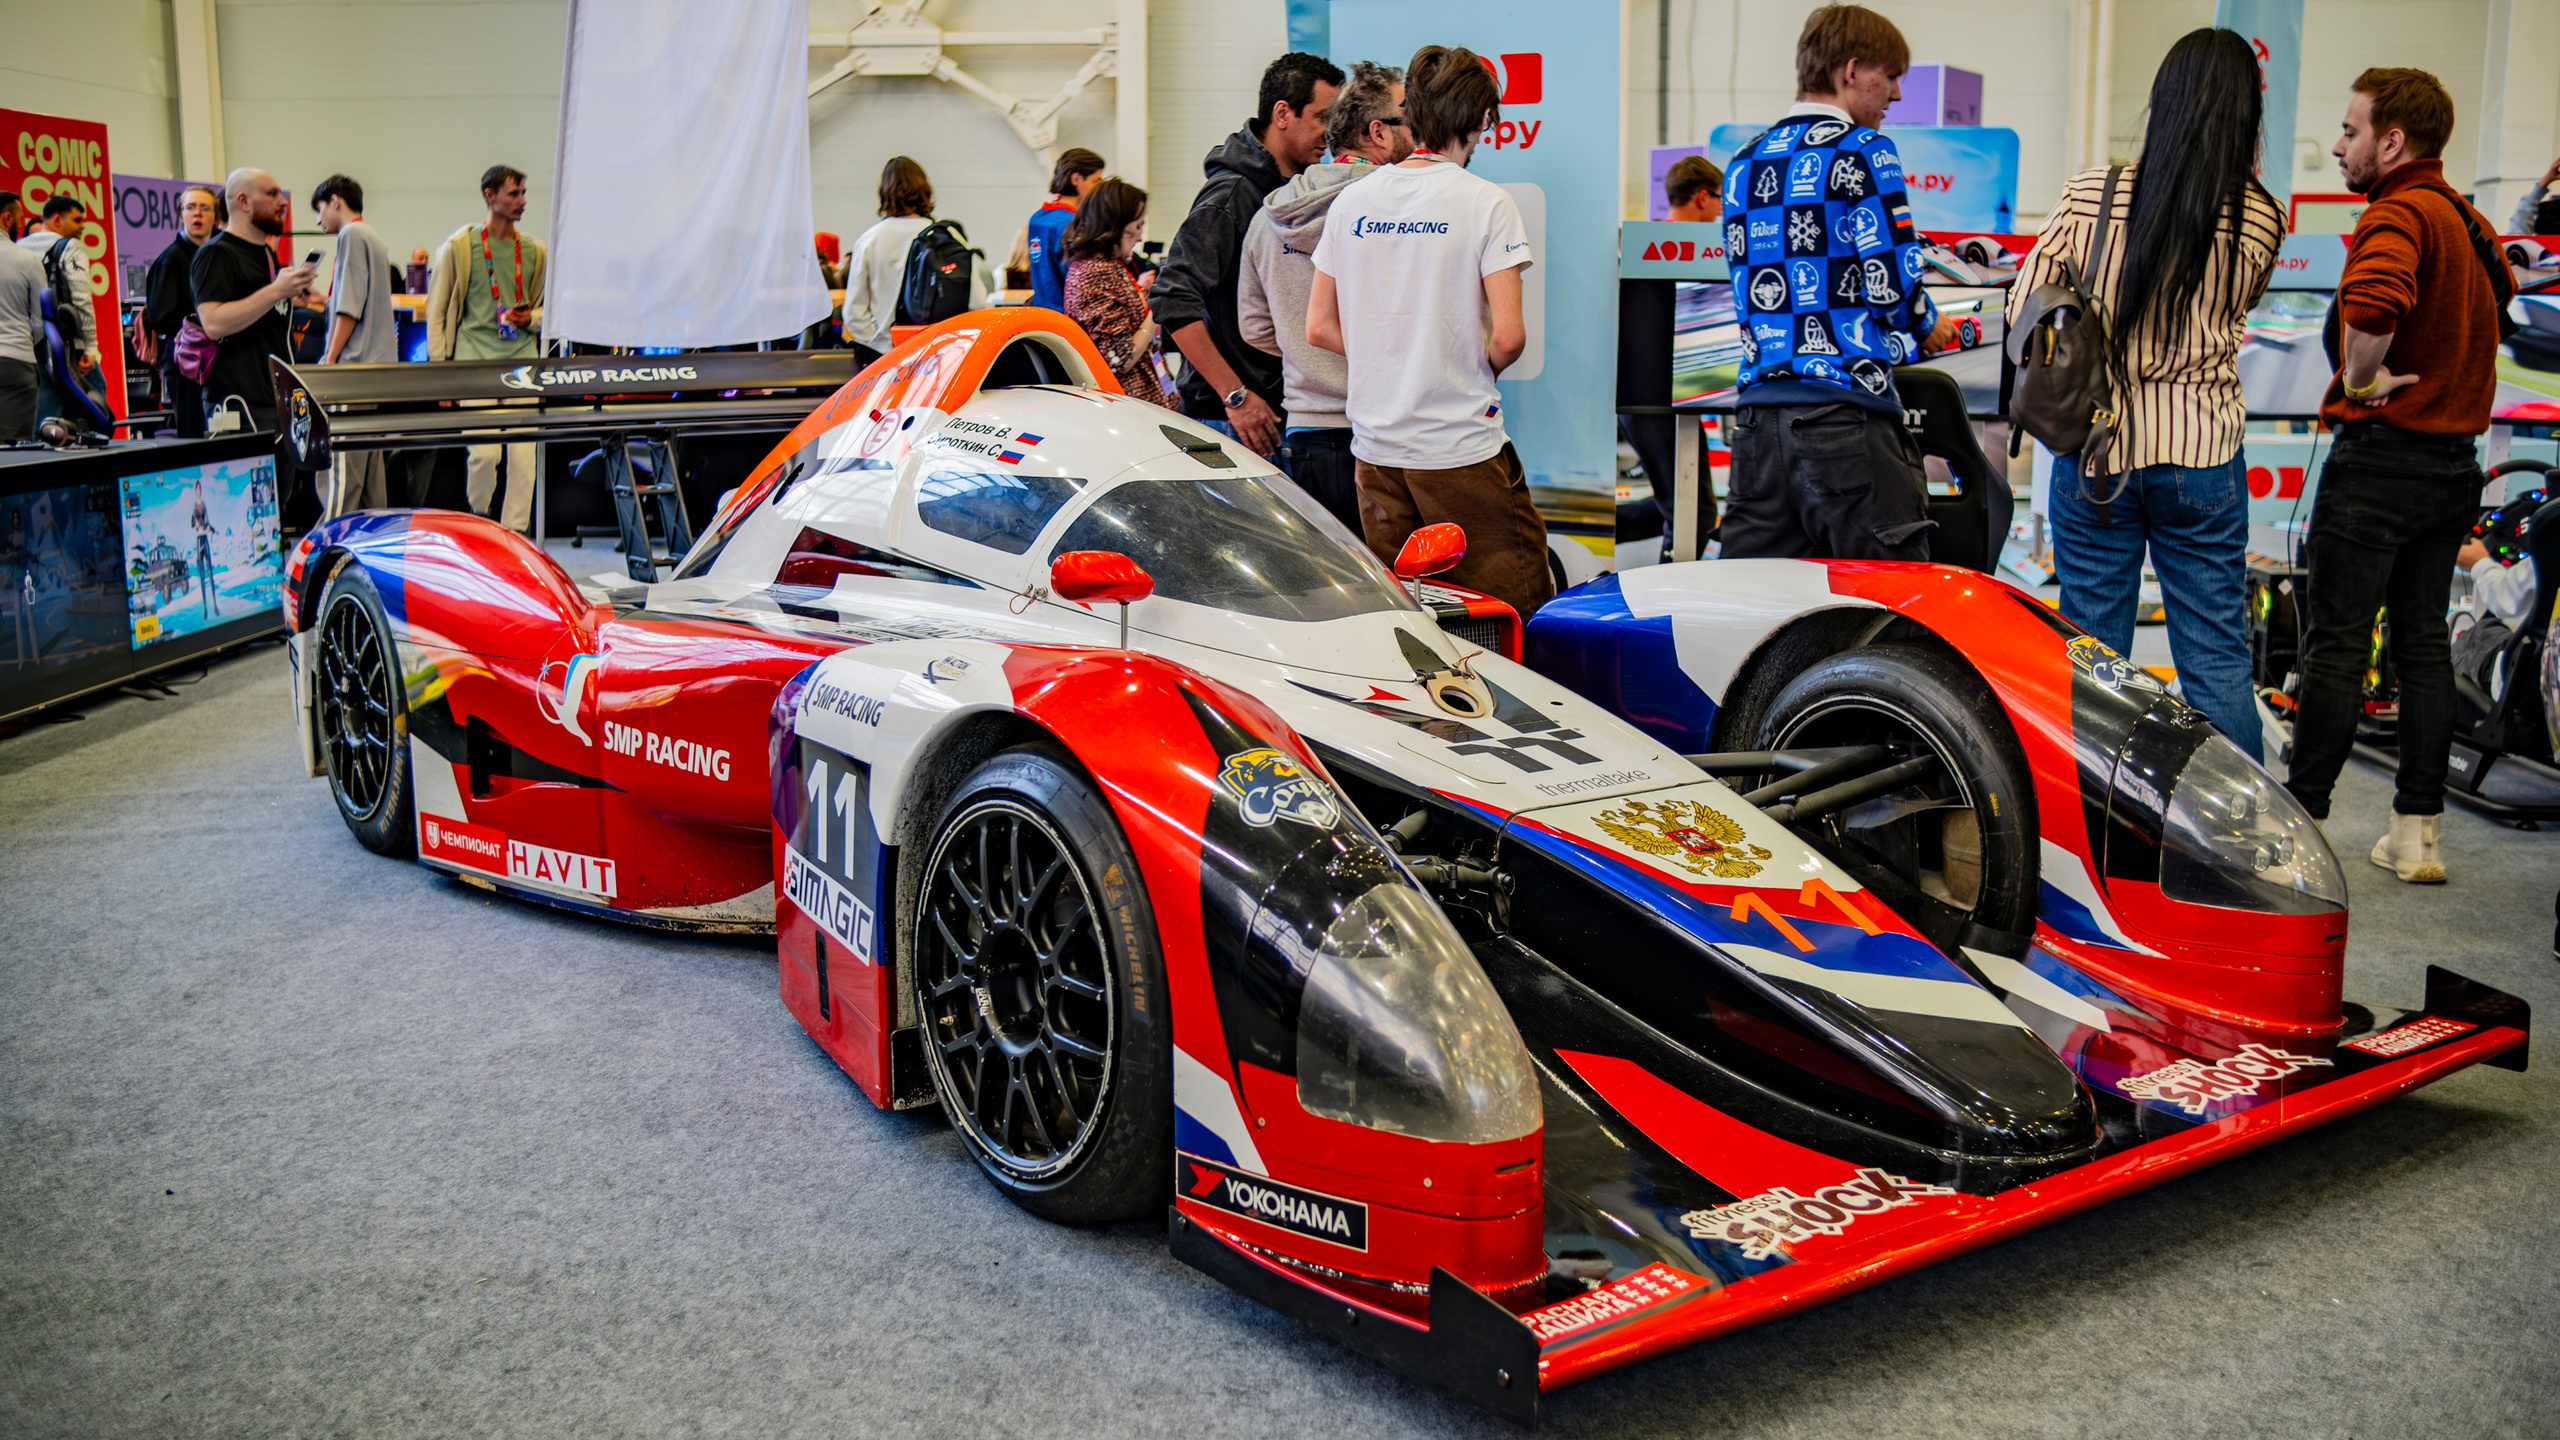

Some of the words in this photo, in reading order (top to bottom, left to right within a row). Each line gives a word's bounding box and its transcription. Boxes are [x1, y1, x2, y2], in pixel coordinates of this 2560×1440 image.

[18, 131, 102, 179] COMIC
[1477, 120, 1542, 151] .ру
[21, 175, 105, 220] CON
[1366, 222, 1396, 234] SMP
[1397, 222, 1449, 234] RACING
[540, 369, 597, 386] SMP
[601, 366, 698, 384] RACING
[839, 376, 875, 408] SMP
[927, 432, 988, 455] Сироткин
[989, 443, 1001, 458] С.
[945, 417, 992, 437] Петров
[993, 426, 1009, 440] В.
[812, 683, 840, 708] SMP
[839, 689, 885, 728] RACING
[603, 720, 643, 757] SMP
[646, 731, 730, 782] RACING
[1535, 769, 1651, 796] thermaltake
[807, 758, 857, 880] 11
[440, 829, 501, 858] ЧЕМПИОНАТ
[511, 842, 612, 893] HAVIT
[785, 854, 871, 955] SIMAGIC
[1730, 877, 1885, 953] 11
[1118, 904, 1147, 1013] MICHELIN
[2121, 1063, 2193, 1092] fitness
[2158, 1045, 2311, 1107] SHOCK
[1224, 1176, 1352, 1238] YOKOHAMA
[1687, 1193, 1782, 1229] fitness
[1725, 1169, 1931, 1248] SHOCK
[1518, 1289, 1618, 1327] РАСНАЯ
[1533, 1298, 1638, 1341] АШИНА
